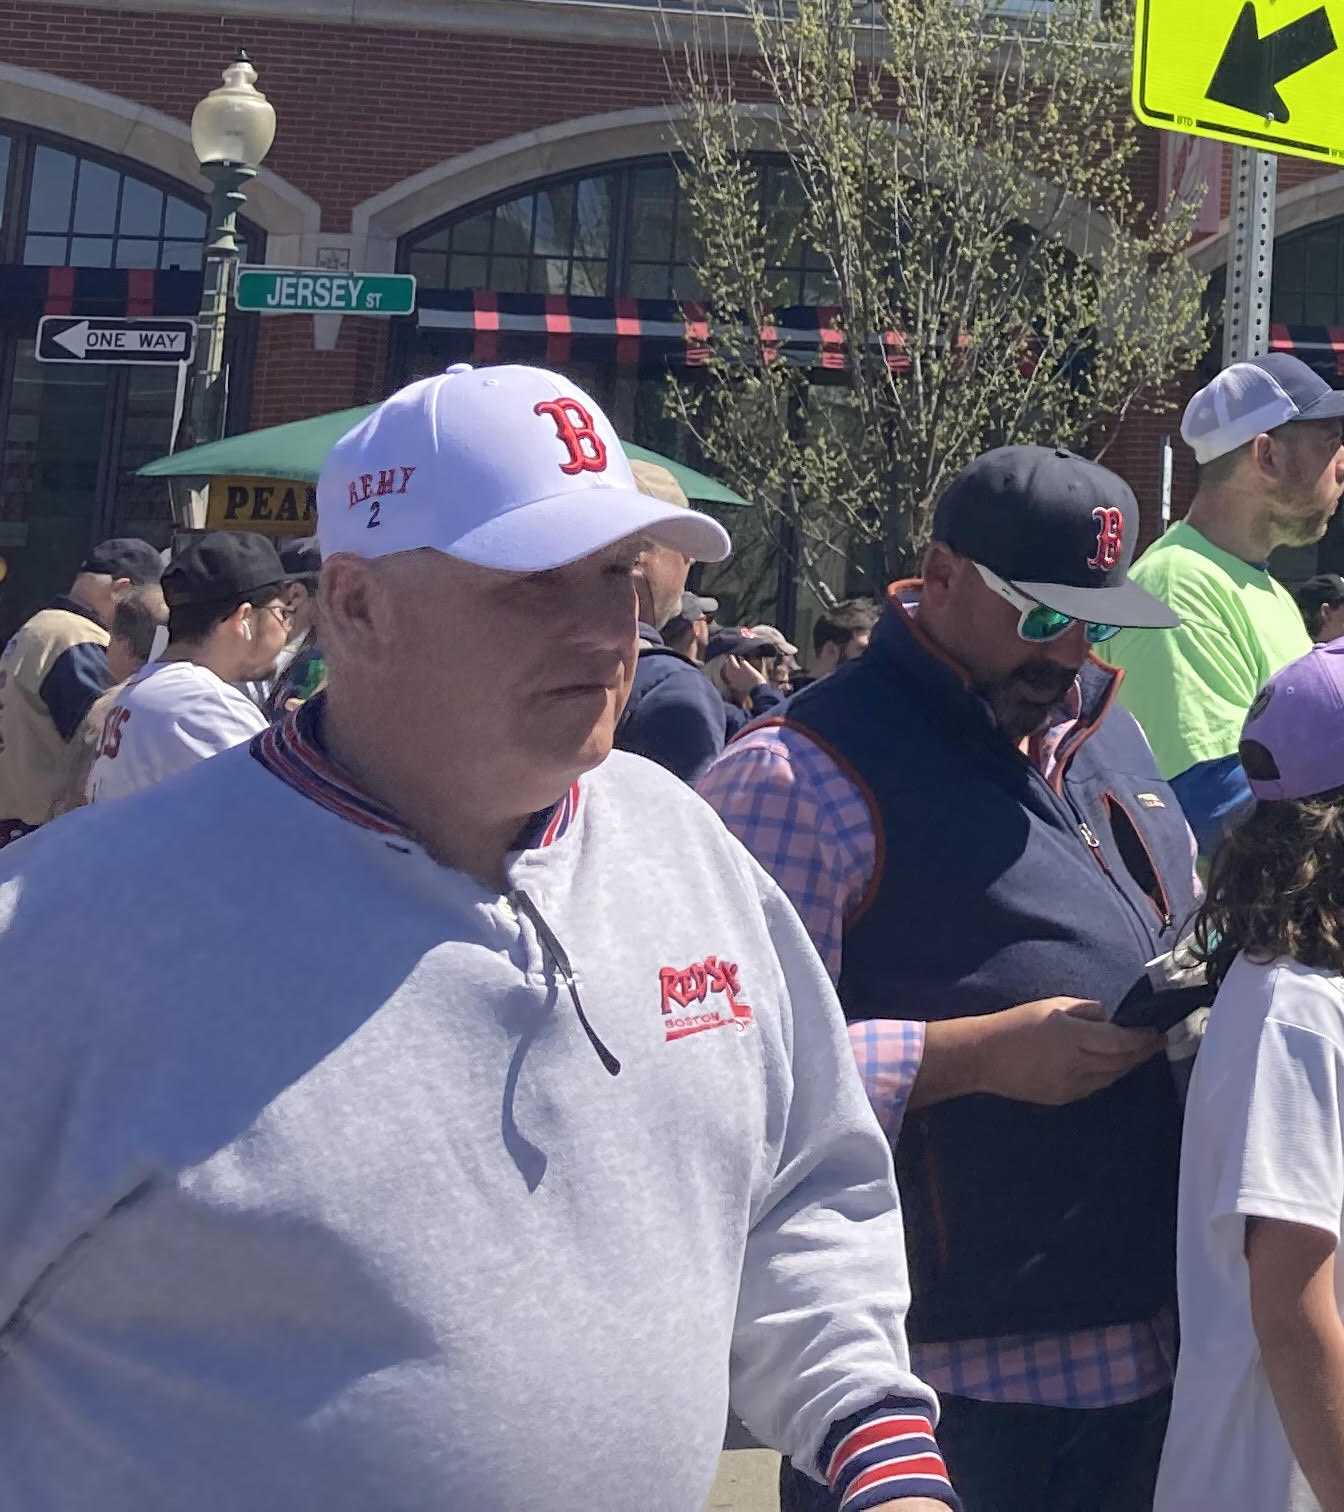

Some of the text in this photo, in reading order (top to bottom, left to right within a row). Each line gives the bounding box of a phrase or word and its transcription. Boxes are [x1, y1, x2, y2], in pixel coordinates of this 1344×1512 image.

[266, 277, 383, 308] JERSEY ST
[86, 332, 180, 349] ONE WAY
[533, 397, 607, 475] B
[366, 501, 381, 529] 2
[1086, 506, 1125, 571] B
[659, 963, 707, 1015] RED
[665, 1011, 719, 1029] BOSTON
